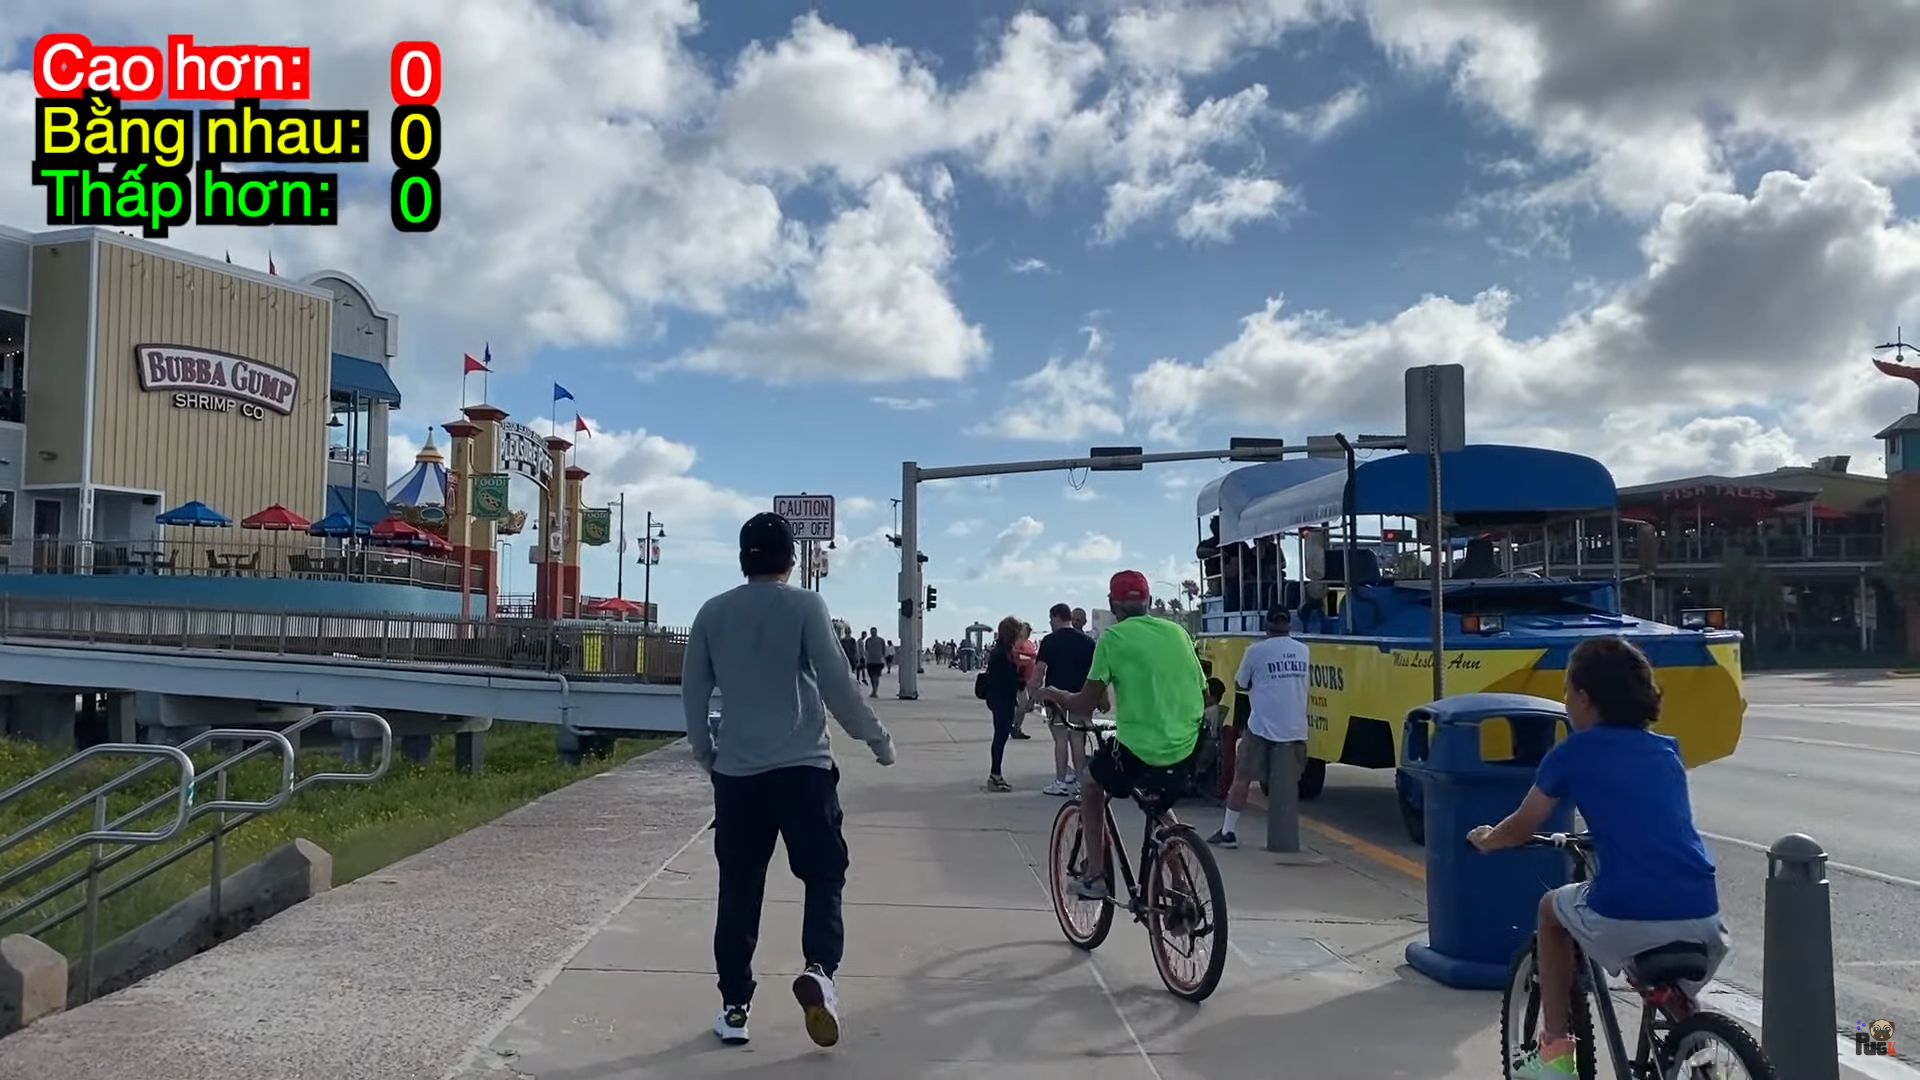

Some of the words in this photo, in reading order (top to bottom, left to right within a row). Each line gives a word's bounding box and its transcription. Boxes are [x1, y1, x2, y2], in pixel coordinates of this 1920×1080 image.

[147, 351, 227, 387] BUBBA
[231, 361, 293, 404] GUMP
[175, 393, 237, 413] SHRIMP
[242, 403, 265, 420] CO
[1662, 484, 1705, 501] FISH
[1714, 485, 1777, 500] TALES
[779, 499, 829, 516] CAUTION
[792, 521, 805, 536] OP
[811, 521, 829, 536] OFF
[1393, 650, 1410, 667] Miss
[1410, 651, 1435, 668] Lesl
[1447, 652, 1482, 670] Ann
[1309, 663, 1344, 691] TOURS
